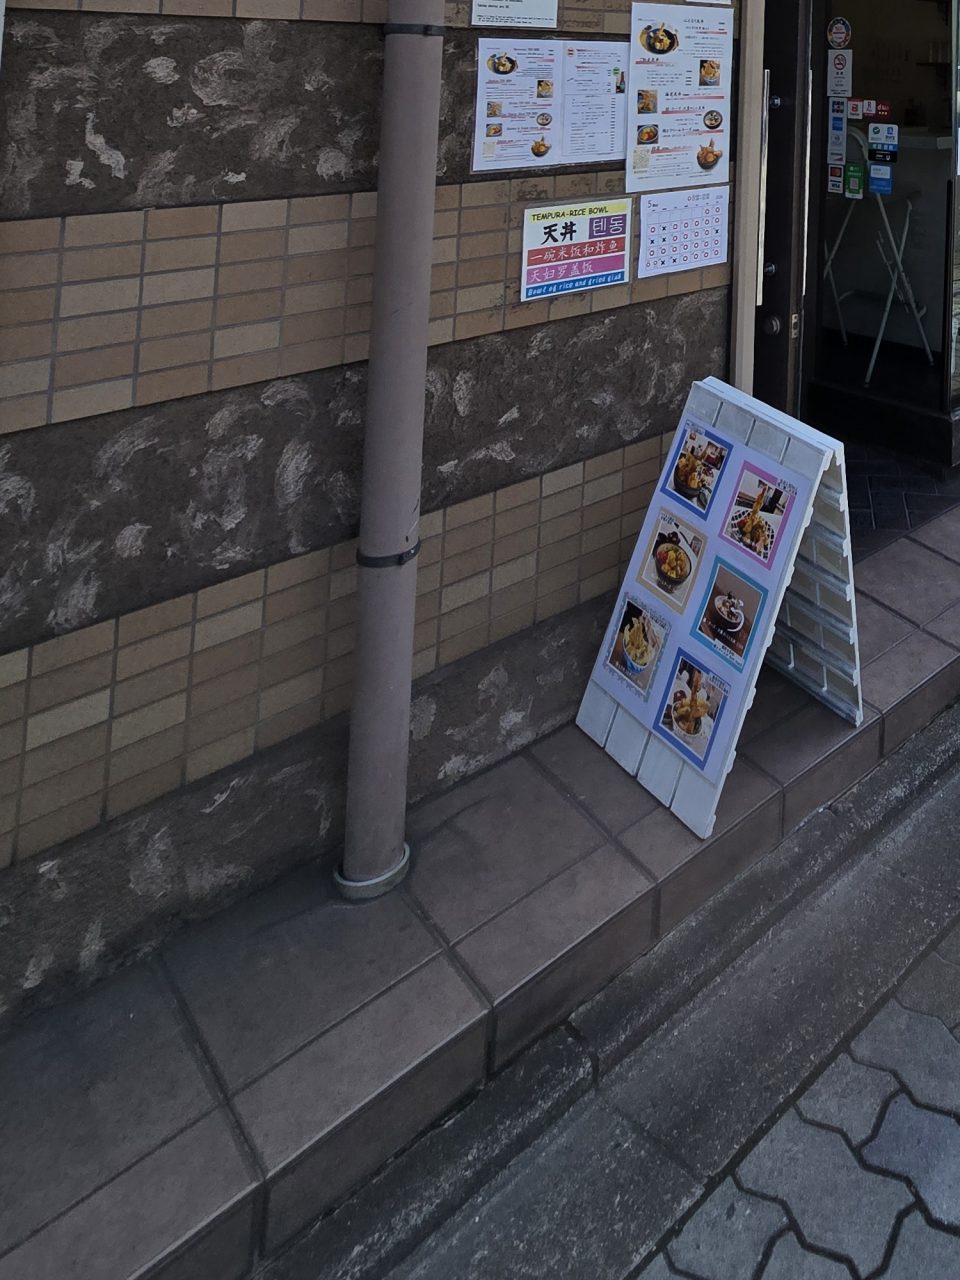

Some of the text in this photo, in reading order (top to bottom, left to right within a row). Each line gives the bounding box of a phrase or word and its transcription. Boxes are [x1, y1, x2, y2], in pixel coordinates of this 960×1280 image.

[531, 206, 609, 221] TEMPURA-RICE BOWL
[541, 221, 577, 246] 天丼
[593, 216, 624, 236] 텐동
[530, 240, 618, 261] 一碗米饭和炸鱼
[528, 261, 594, 283] 天妇罗盖饭
[528, 286, 547, 296] Bowl
